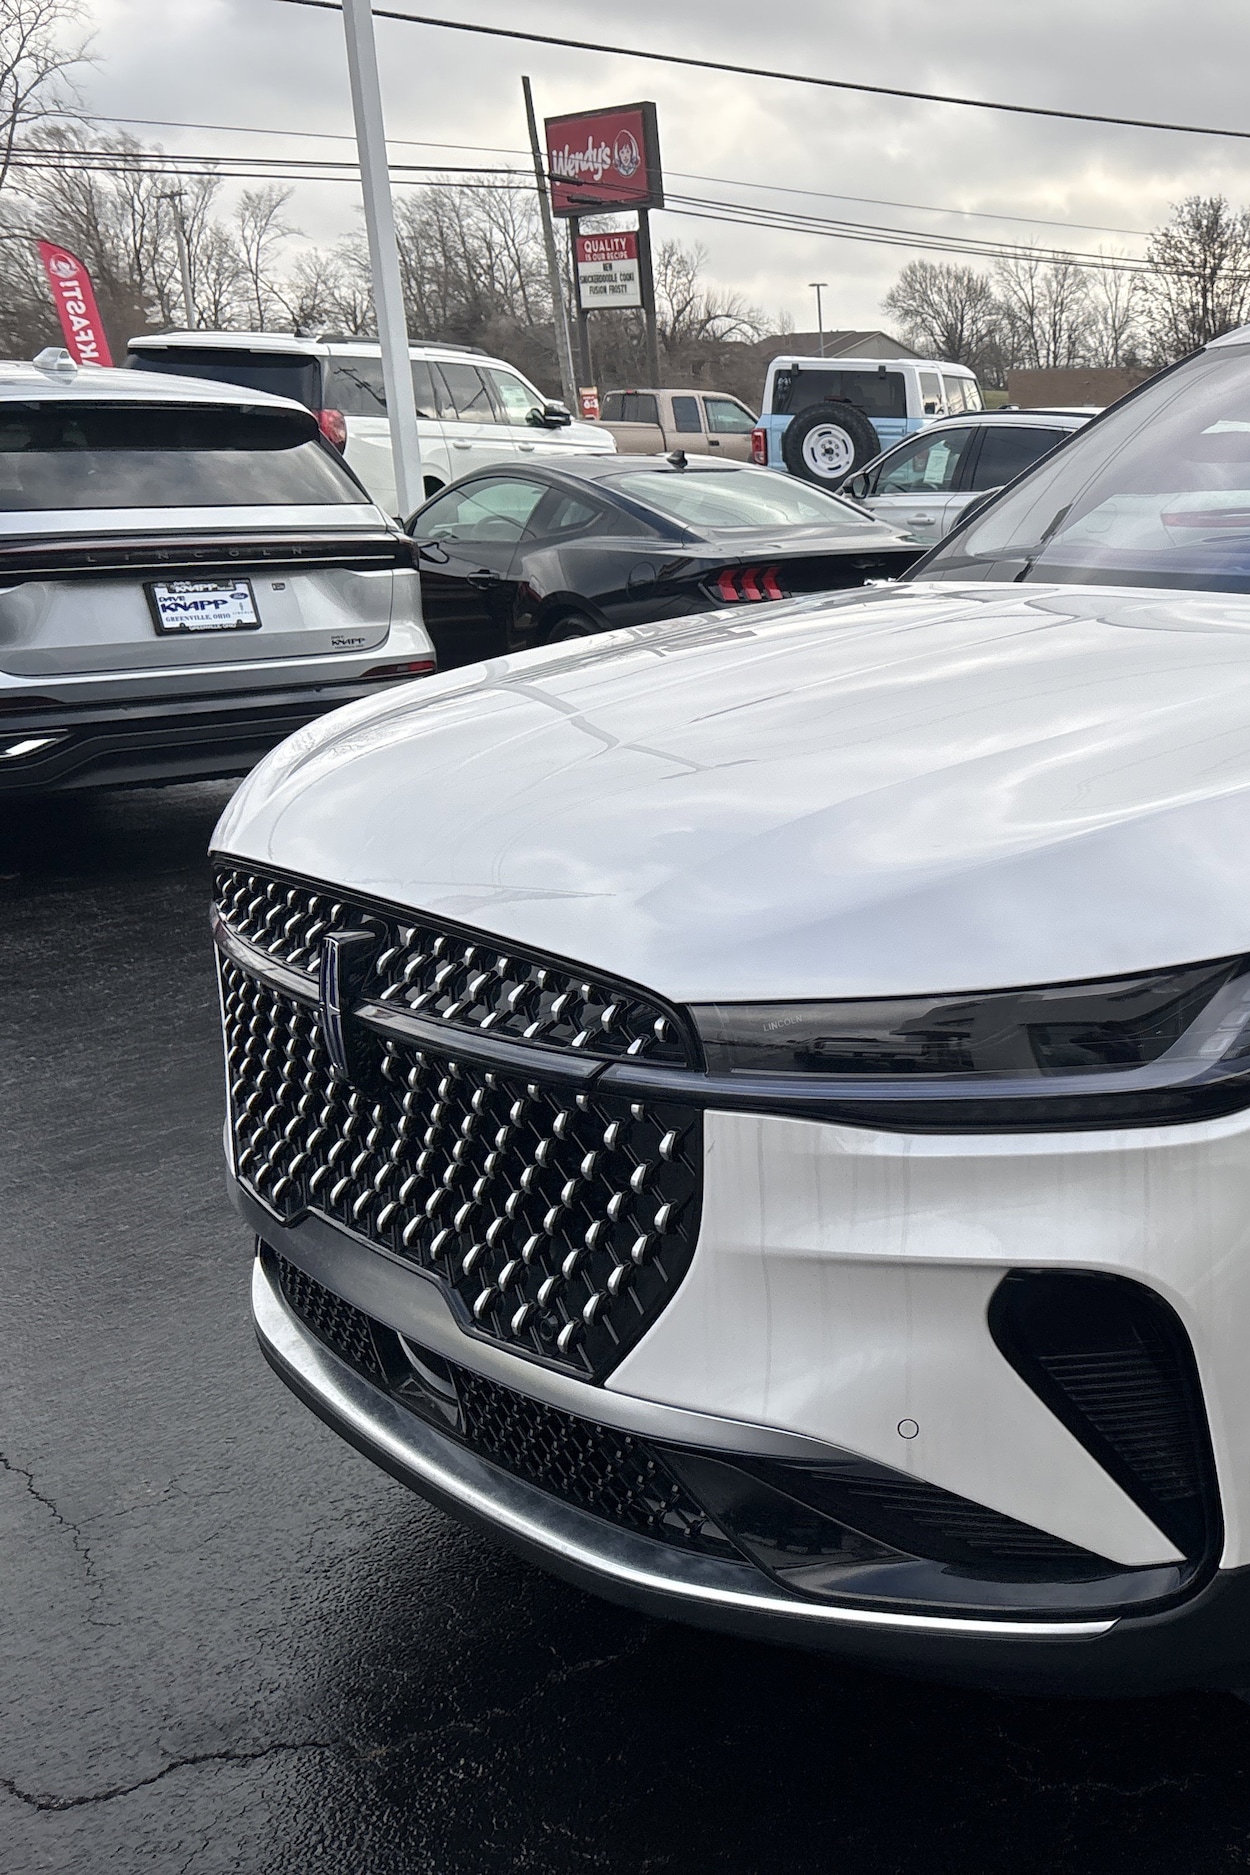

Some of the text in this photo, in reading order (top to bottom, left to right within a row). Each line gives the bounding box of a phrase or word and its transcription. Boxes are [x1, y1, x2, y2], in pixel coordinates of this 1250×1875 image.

[551, 135, 612, 181] Wendy's
[583, 237, 627, 253] QUALITY
[585, 251, 628, 261] IS OUR RECIPE
[589, 285, 607, 294] FUSION
[87, 546, 303, 563] LINCOLN
[160, 599, 228, 613] KNAPP
[165, 614, 212, 622] GREENVILLE,
[763, 1015, 803, 1031] LINCOLN
